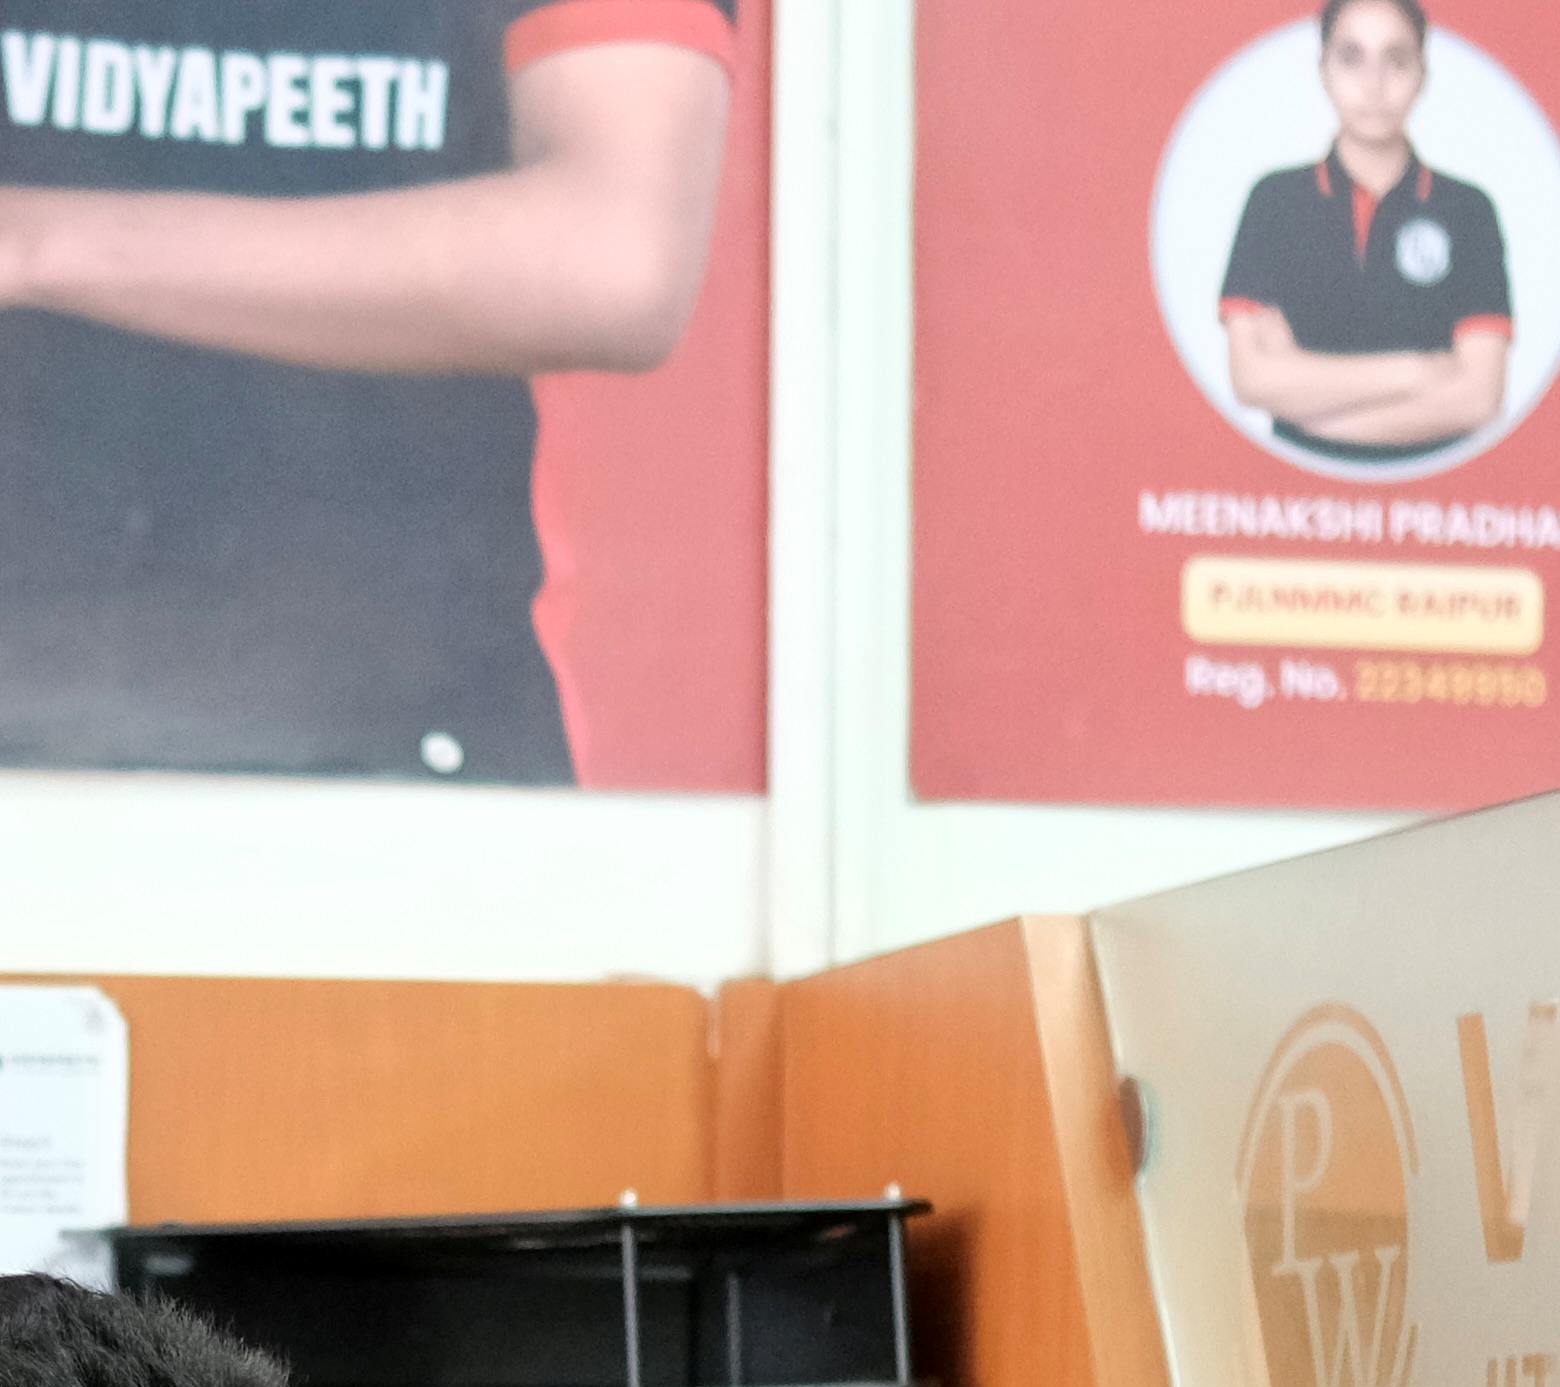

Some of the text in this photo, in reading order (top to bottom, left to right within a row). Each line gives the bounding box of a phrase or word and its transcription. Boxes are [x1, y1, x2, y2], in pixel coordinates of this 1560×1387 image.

[0, 29, 448, 153] VIDYAPEETH
[1138, 490, 1383, 543] MEENAKSHI
[1394, 586, 1523, 624] RAIPUR
[1183, 654, 1276, 708] Reg.
